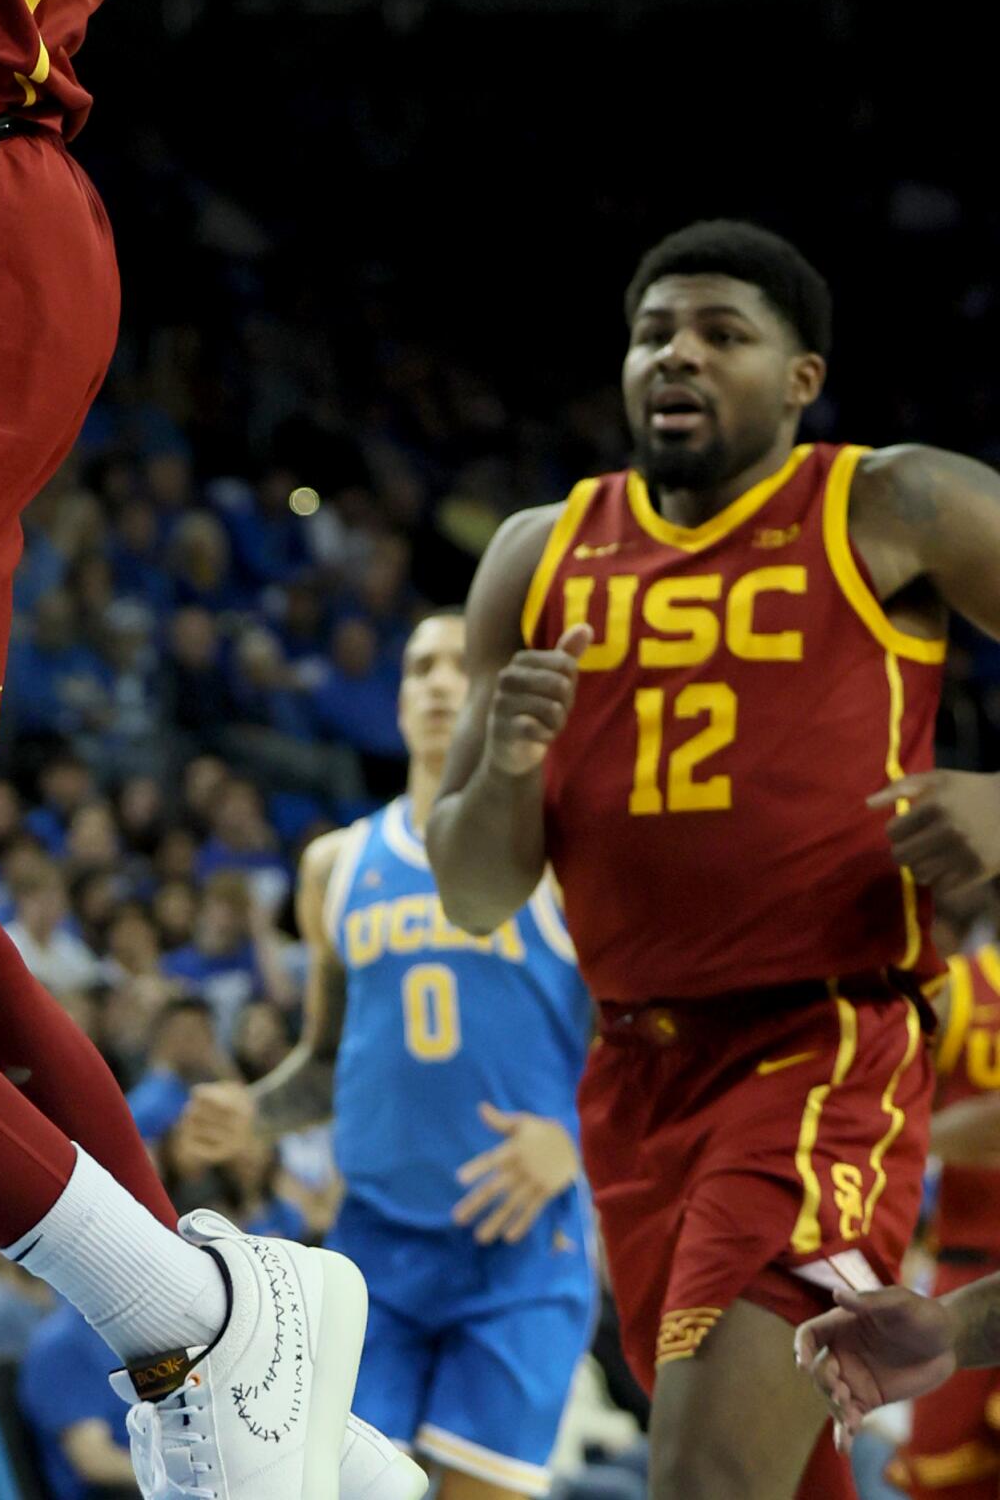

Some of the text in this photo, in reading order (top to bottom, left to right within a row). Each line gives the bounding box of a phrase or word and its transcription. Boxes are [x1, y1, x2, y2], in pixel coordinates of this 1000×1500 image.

[563, 565, 808, 672] USC
[628, 681, 738, 816] 12
[402, 962, 462, 1063] 0
